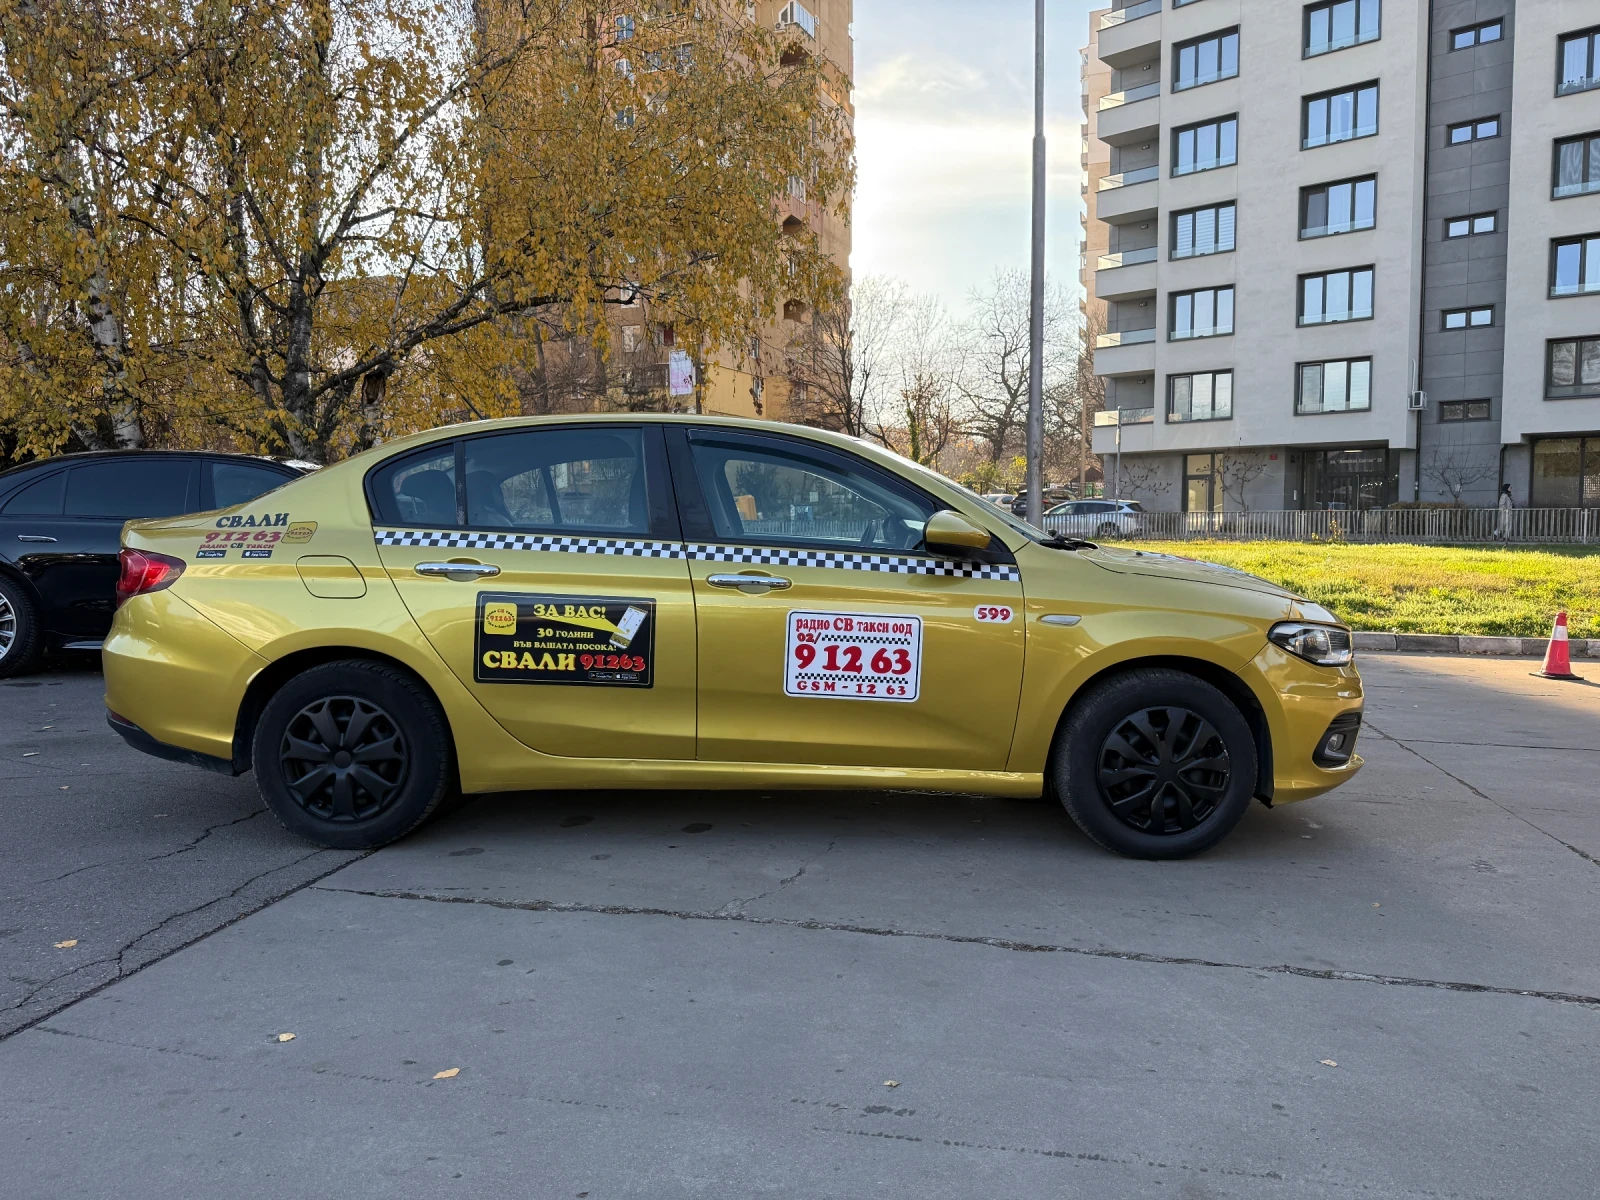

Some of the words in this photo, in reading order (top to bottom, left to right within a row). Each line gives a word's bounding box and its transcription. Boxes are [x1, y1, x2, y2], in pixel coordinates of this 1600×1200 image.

[215, 512, 290, 528] СВАЛИ
[533, 603, 559, 617] ЗА
[563, 604, 606, 619] ВАС!
[977, 607, 1011, 621] 599
[536, 628, 554, 638] 30
[795, 618, 830, 632] радио
[833, 617, 854, 632] СВ
[856, 621, 889, 634] такси
[892, 622, 913, 637] оод
[513, 640, 532, 648] ВЪВ
[534, 641, 574, 650] ВАШАТА
[576, 643, 617, 651] ПОСОКА!
[482, 650, 576, 671] СВАЛИ
[580, 653, 646, 672] 91263
